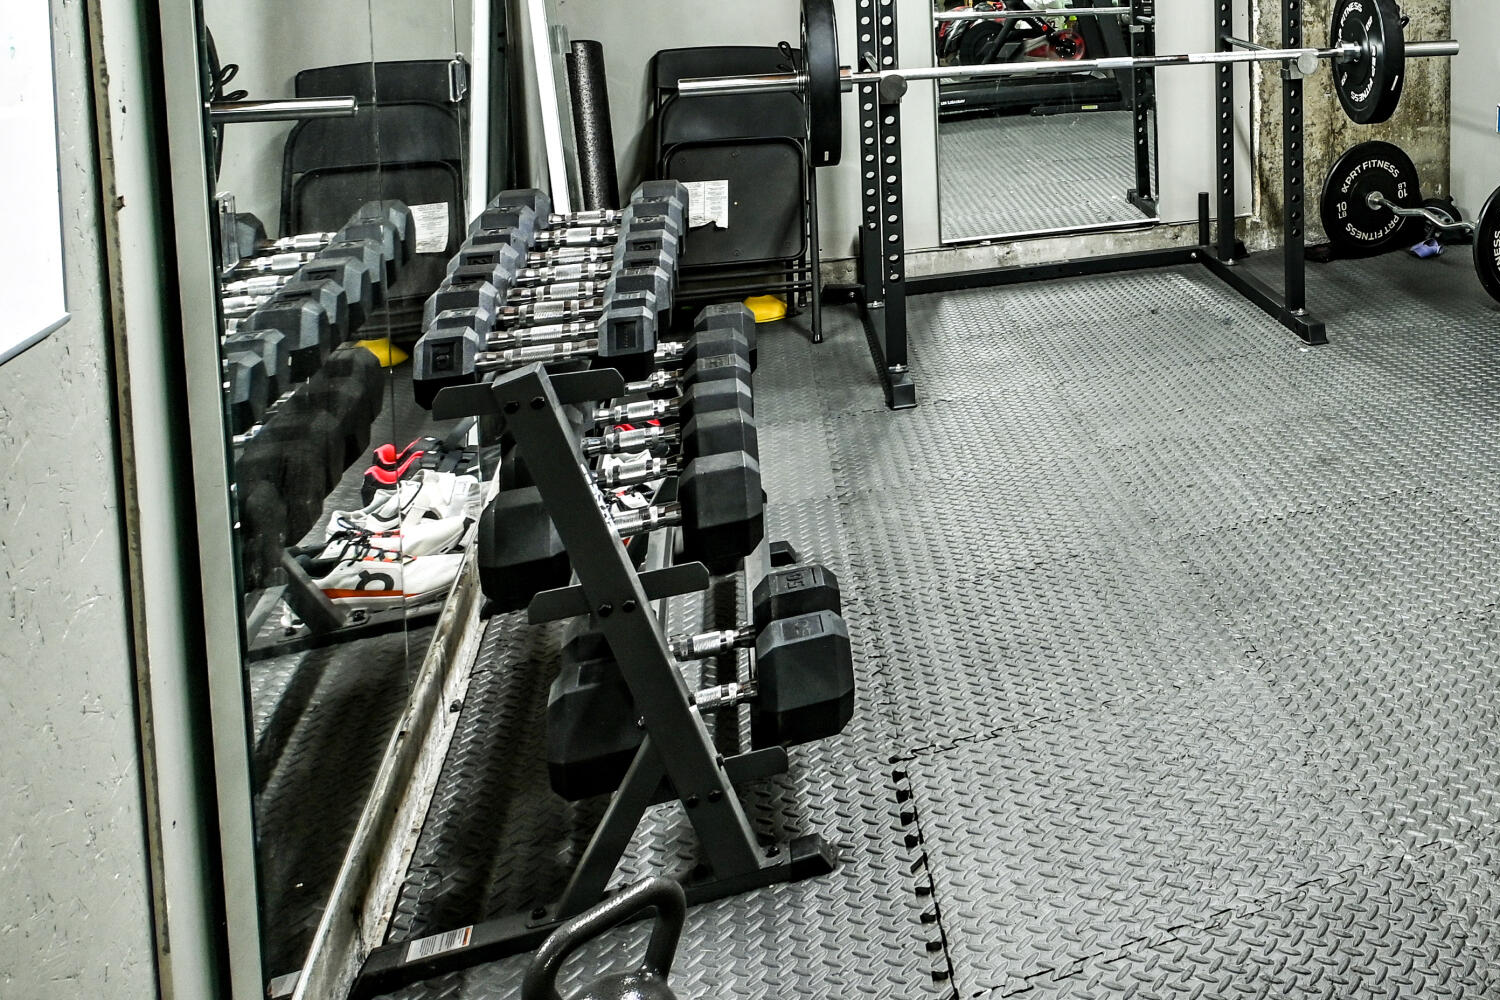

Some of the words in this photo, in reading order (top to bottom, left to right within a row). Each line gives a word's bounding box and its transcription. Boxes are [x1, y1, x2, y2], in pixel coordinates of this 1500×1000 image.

[1362, 159, 1400, 178] FITNESS
[1397, 181, 1406, 190] LB
[1397, 189, 1408, 199] 10
[1336, 201, 1347, 212] 10
[1338, 211, 1347, 219] LB
[1345, 223, 1383, 240] FITNESS
